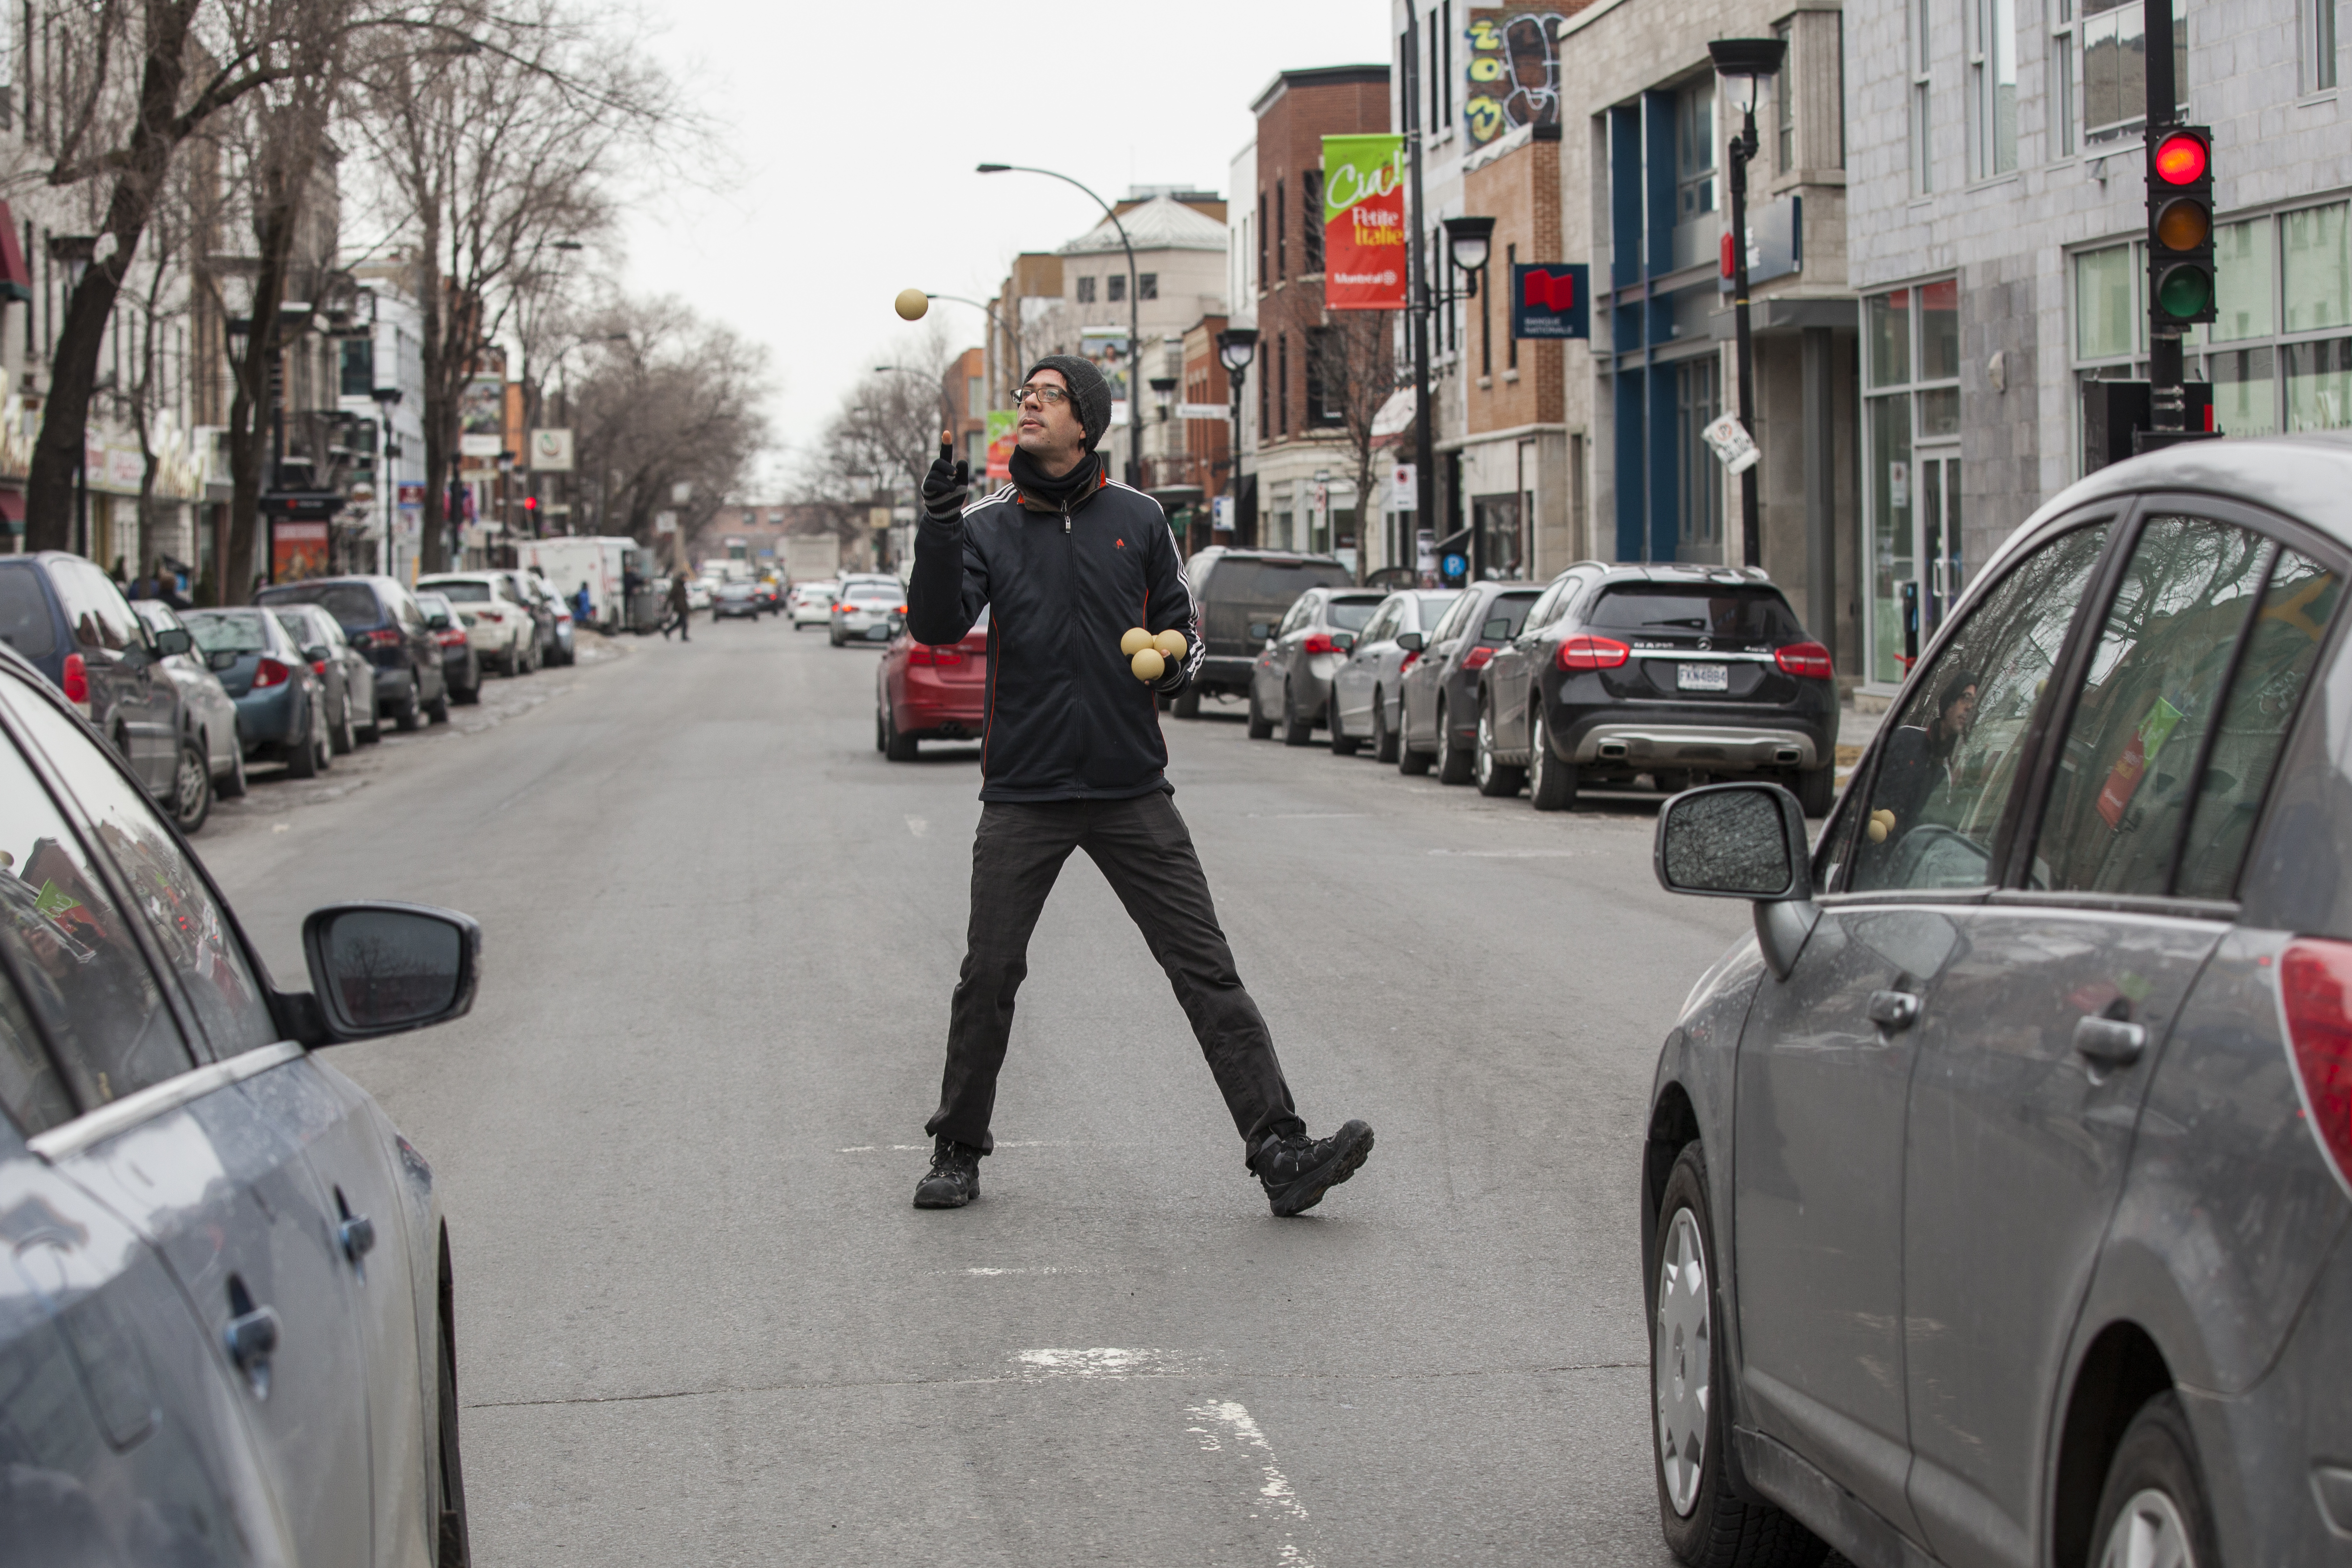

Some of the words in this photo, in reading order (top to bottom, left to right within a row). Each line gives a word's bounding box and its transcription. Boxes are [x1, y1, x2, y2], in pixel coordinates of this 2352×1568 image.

[1327, 150, 1400, 209] Ciao!
[1352, 206, 1399, 226] Petite
[1355, 224, 1403, 246] Italie
[1334, 271, 1382, 284] Montréal
[1524, 317, 1561, 325] BANQUE
[1524, 325, 1573, 335] NATIONALE
